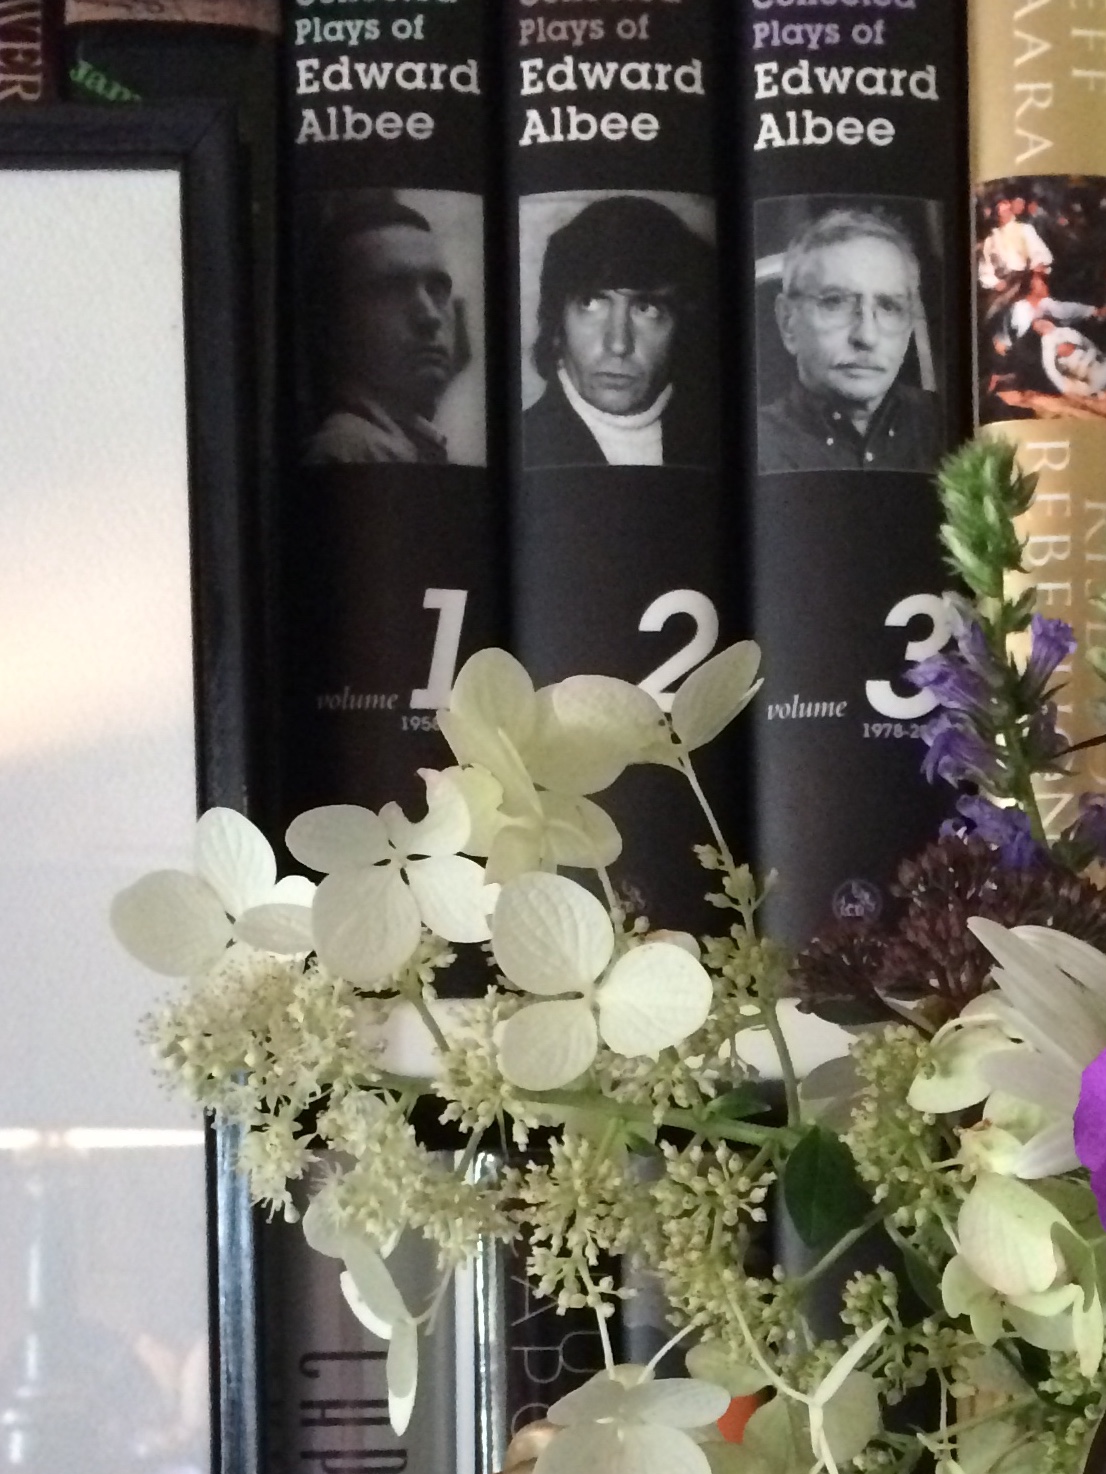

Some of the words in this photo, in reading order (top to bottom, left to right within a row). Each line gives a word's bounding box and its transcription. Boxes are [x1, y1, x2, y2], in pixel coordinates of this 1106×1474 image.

[295, 17, 380, 45] Plays
[391, 14, 424, 39] of
[519, 16, 605, 46] Plays
[617, 14, 650, 40] of
[752, 19, 840, 50] Plays
[852, 18, 885, 45] of
[296, 55, 481, 95] Edward
[519, 56, 705, 95] Edward
[754, 60, 939, 100] Edward
[295, 105, 434, 144] Albee
[519, 106, 660, 146] Albee
[754, 109, 896, 151] Albee
[316, 686, 400, 711] volume
[409, 588, 468, 710] 1
[637, 589, 720, 714] 2
[767, 694, 848, 720] volume
[865, 593, 952, 720] 3
[862, 723, 925, 738] 1978-2
